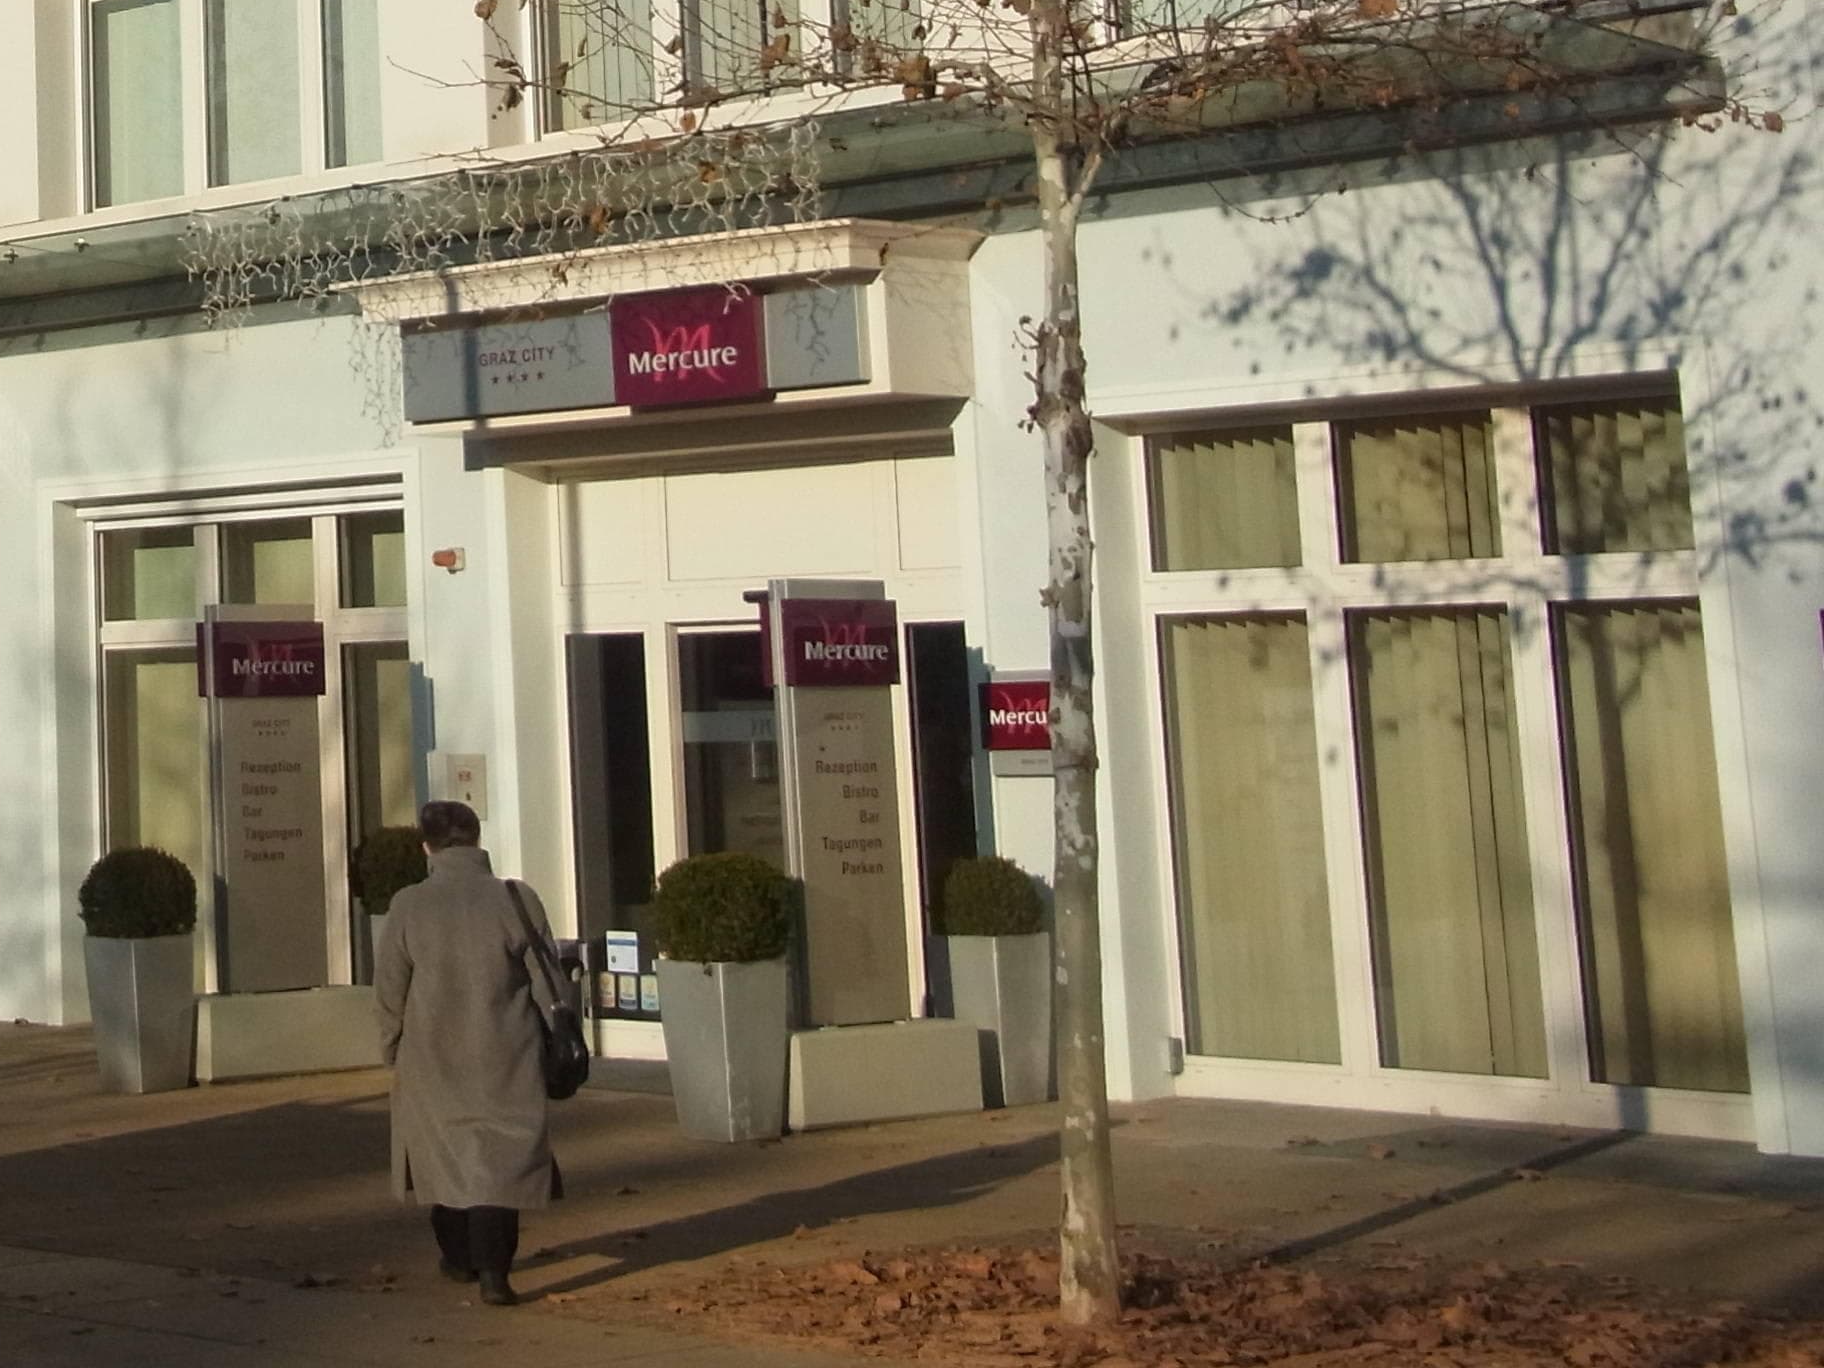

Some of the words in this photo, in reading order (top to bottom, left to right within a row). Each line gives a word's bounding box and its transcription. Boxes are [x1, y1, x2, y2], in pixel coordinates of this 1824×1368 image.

[479, 349, 517, 367] GRAZ
[521, 346, 556, 363] CITY
[628, 345, 738, 376] Mercure
[805, 641, 889, 661] Mercure
[232, 657, 315, 675] Mercure
[989, 709, 1048, 726] Mercu
[241, 760, 301, 776] Rezeption
[816, 760, 878, 777] Rezeption
[242, 784, 278, 797] Bistro
[842, 784, 879, 799] Bistro
[242, 806, 263, 818] Bar
[859, 810, 880, 823] Bar
[244, 828, 303, 844] Tagungen
[822, 836, 883, 854] Tagungen
[244, 849, 286, 862] Parken
[842, 861, 884, 875] Parken
